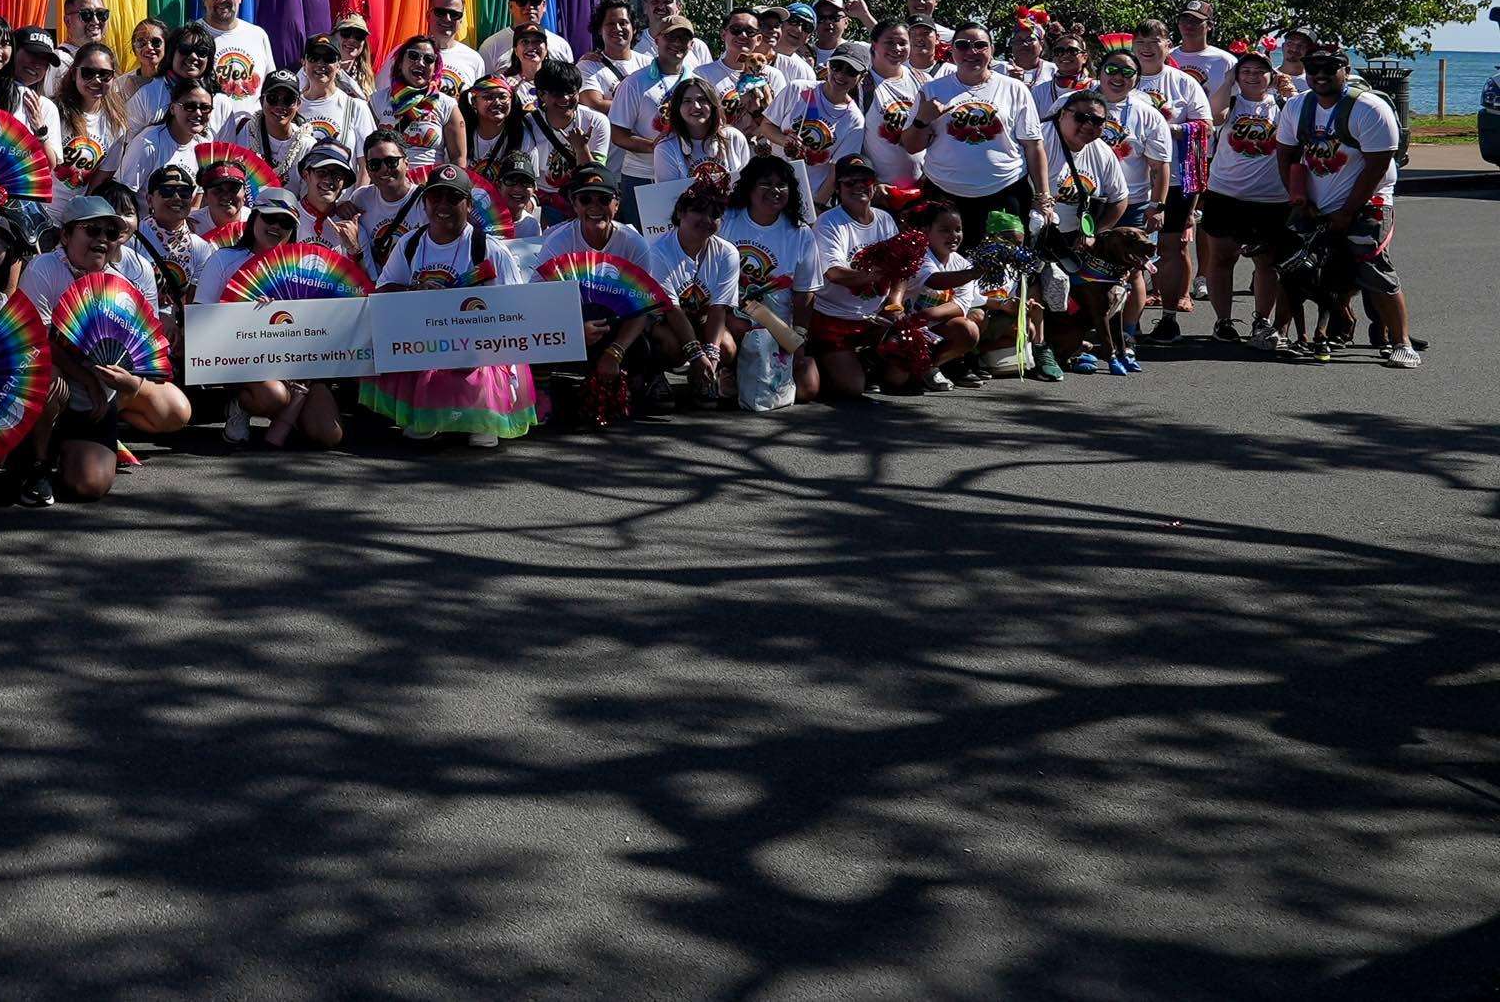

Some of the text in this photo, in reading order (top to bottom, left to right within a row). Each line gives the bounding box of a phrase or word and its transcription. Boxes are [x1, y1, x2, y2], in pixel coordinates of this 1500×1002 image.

[215, 64, 255, 83] Yes!
[646, 225, 665, 234] The
[284, 273, 333, 290] Hawaiian
[337, 284, 364, 295] Bank
[628, 290, 656, 301] Bank
[426, 312, 523, 326] First Hawaiian Bank
[236, 327, 328, 339] First Hawaiian Bank
[392, 332, 566, 355] PROUDLY saying YES!
[190, 357, 211, 367] The
[214, 354, 250, 366] Power
[252, 352, 265, 365] of
[267, 352, 282, 364] Us
[284, 351, 318, 363] Starts
[319, 349, 346, 361] with
